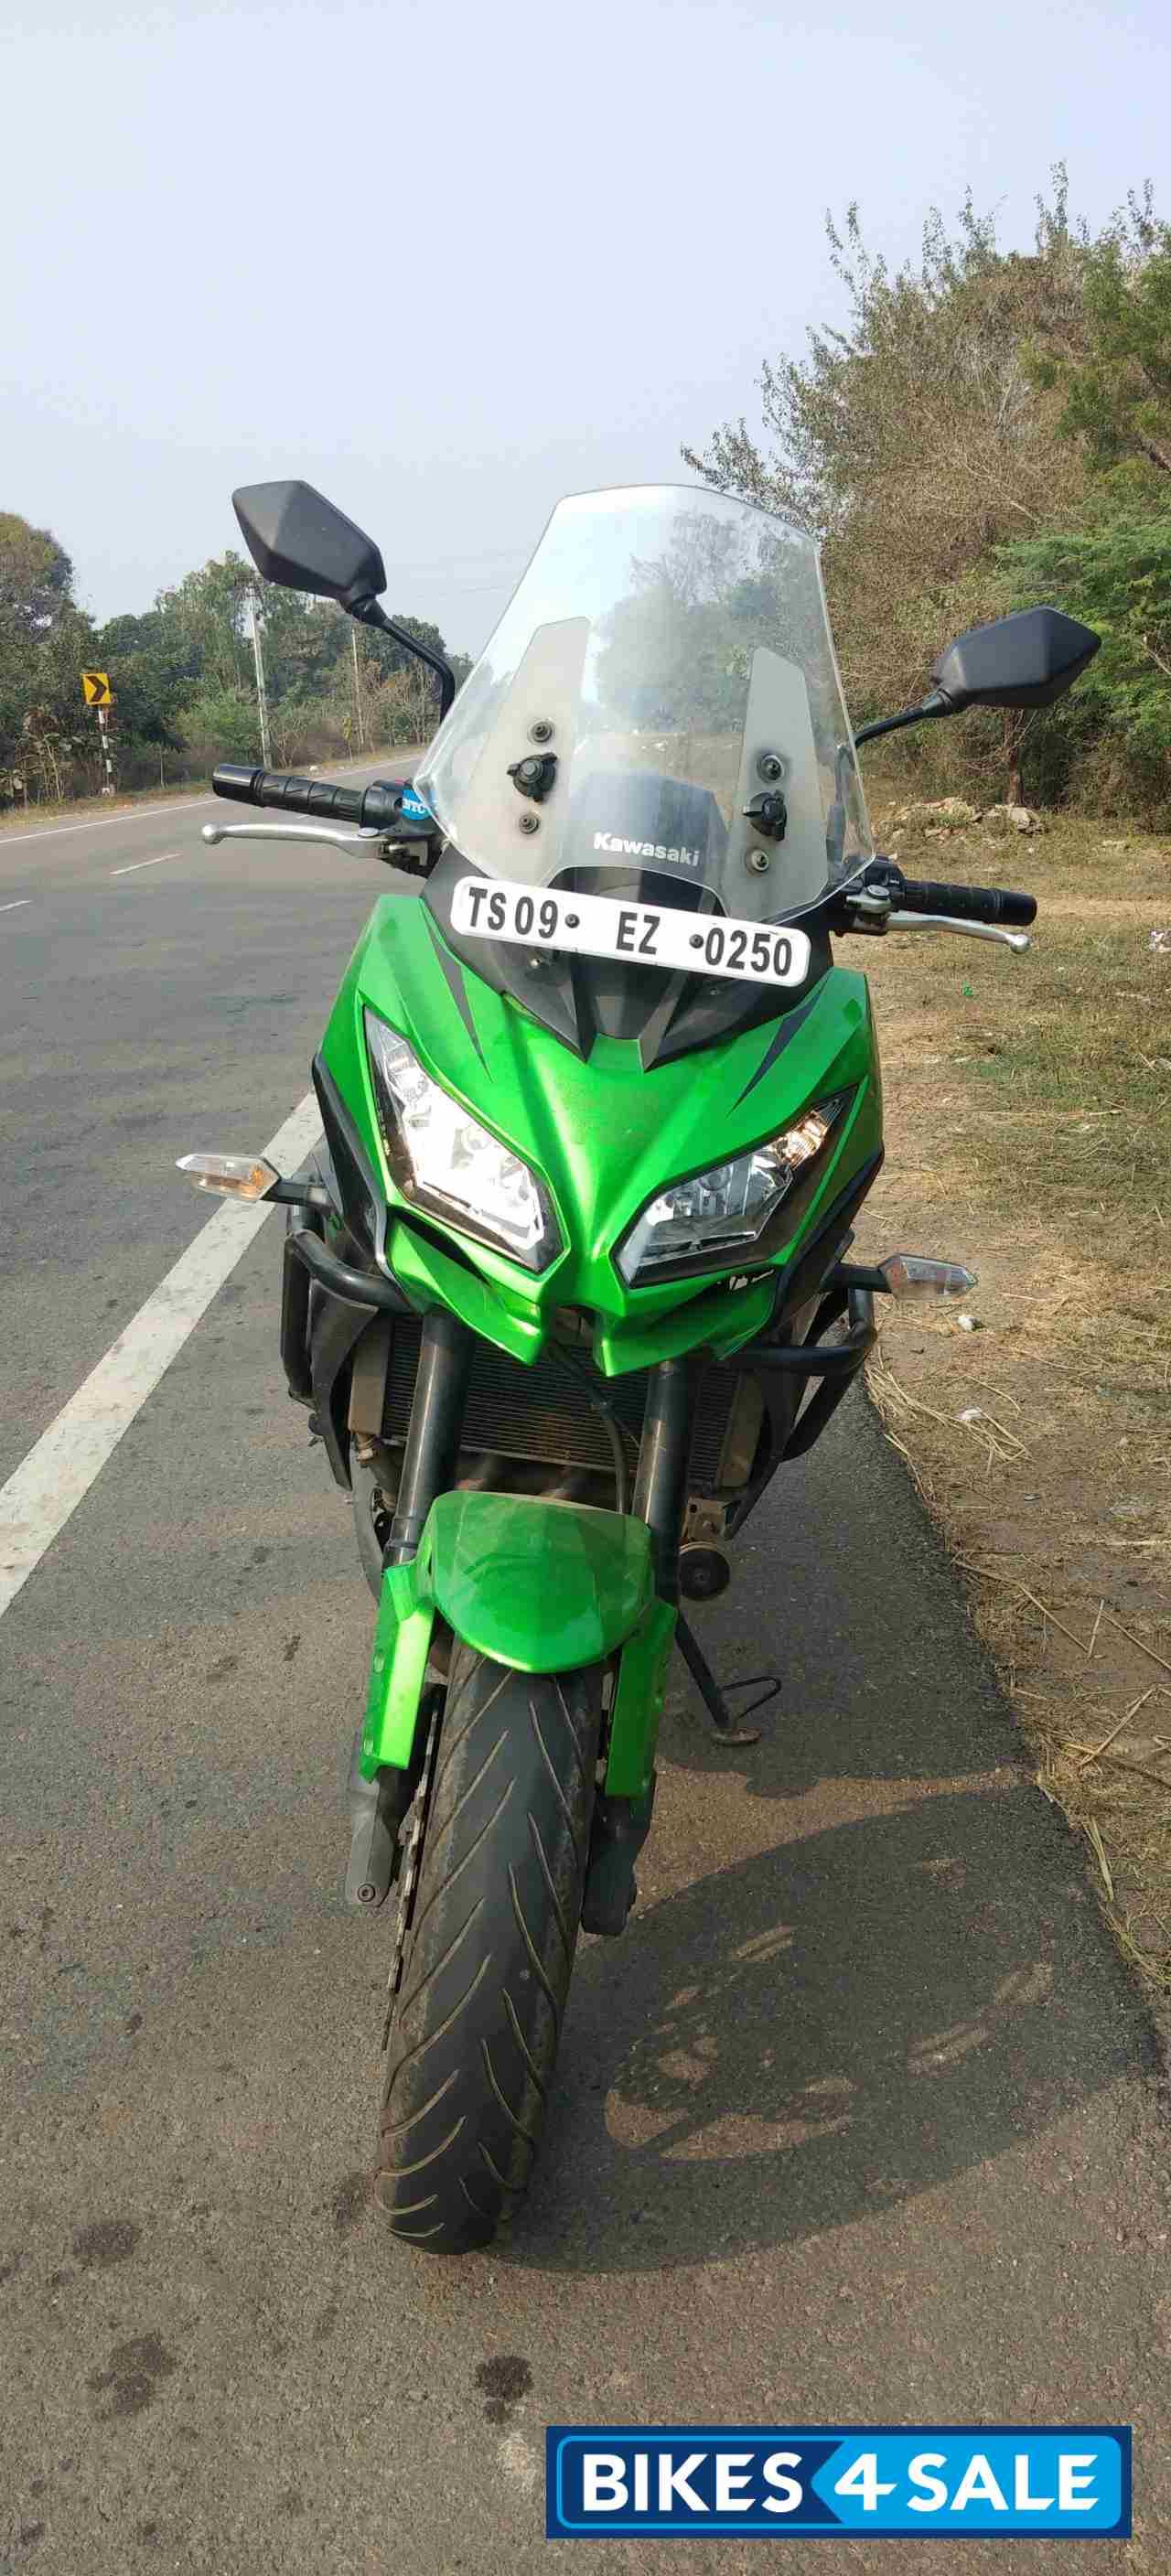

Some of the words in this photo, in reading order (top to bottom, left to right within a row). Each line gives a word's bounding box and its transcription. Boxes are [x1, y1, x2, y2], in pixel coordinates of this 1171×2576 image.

[594, 832, 700, 866] Kawasaki
[467, 886, 558, 939] TS09
[617, 911, 661, 955] EZ
[705, 928, 793, 977] 0250
